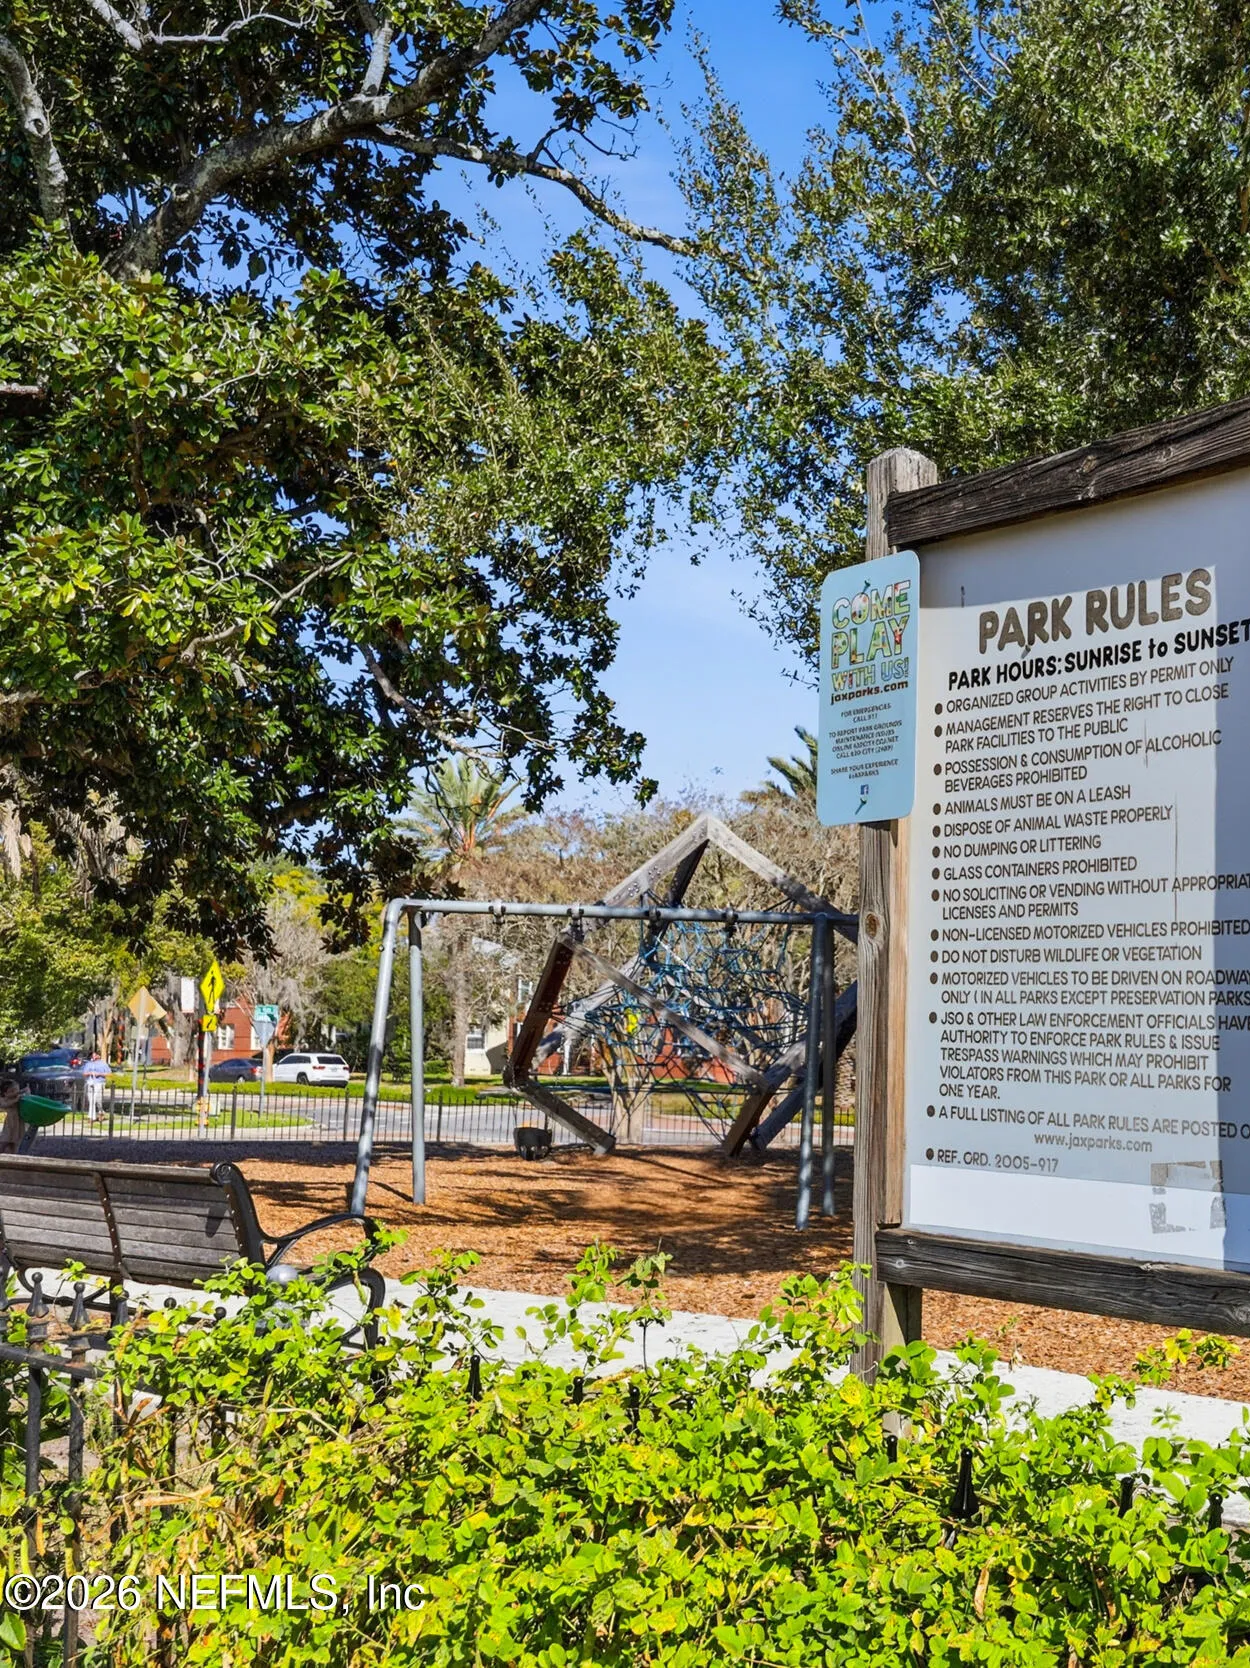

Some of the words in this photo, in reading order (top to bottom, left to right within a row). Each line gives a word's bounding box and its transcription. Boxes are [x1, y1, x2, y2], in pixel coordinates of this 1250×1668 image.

[832, 580, 911, 629] COME
[979, 596, 1072, 654] PARK
[1086, 569, 1211, 635] RULES
[831, 615, 910, 669] PLAY
[832, 664, 875, 692] WITH
[881, 657, 909, 681] US!
[949, 666, 991, 691] PARK
[1148, 638, 1168, 659] to
[831, 680, 908, 705] jaxparks.com
[946, 691, 1014, 713] ORGANIZED
[1016, 685, 1057, 704] GROUP
[1060, 674, 1127, 697] ACTIVITIES
[1129, 670, 1147, 687] BY
[1150, 662, 1197, 684] PERMIT
[1199, 657, 1234, 676] ONLY
[946, 711, 1030, 736] MANAGEMENT
[1033, 703, 1093, 725] RESERVES
[1096, 699, 1121, 716] THE
[1123, 692, 1161, 712] RIGHT
[1164, 690, 1183, 706] TO
[1185, 683, 1229, 703] CLOSE
[945, 738, 974, 754] PARK
[976, 730, 1035, 750] FACILITIES
[1038, 727, 1055, 742] TO
[1057, 723, 1081, 740] THE
[1084, 718, 1128, 737] PUBLIC
[945, 755, 1017, 775] POSSESSION
[1020, 753, 1028, 768] &
[1031, 742, 1122, 766] CONSUMPTION
[1125, 739, 1143, 755] OF
[1145, 730, 1222, 754] ALCOHOLIC
[945, 773, 1013, 793] BEVERAGES
[1016, 766, 1087, 786] PROHIBITED
[944, 797, 998, 815] ANIMALS
[1000, 794, 1034, 810] MUST
[1036, 792, 1052, 807] BE
[1054, 790, 1073, 806] ON
[1076, 789, 1087, 804] A
[1089, 784, 1131, 803] LEASH
[944, 820, 992, 837] DISPOSE
[995, 819, 1011, 833] OF
[1013, 816, 1061, 832] ANIMAL
[1064, 810, 1108, 828] WASTE
[1110, 805, 1173, 824] PROPERLY
[944, 844, 962, 858] NO
[964, 840, 1017, 858] DUMPING
[1020, 839, 1037, 854] OR
[1040, 835, 1101, 853] LITTERING
[944, 865, 982, 881] GLASS
[985, 861, 1059, 879] CONTAINERS
[1062, 856, 1137, 875] PROHIBITED
[943, 888, 961, 902] NO
[963, 885, 1027, 902] SOLICITING
[1029, 884, 1047, 899] OR
[1049, 881, 1105, 898] VENDING
[1107, 878, 1168, 895] WITHOUT
[943, 905, 996, 920] LICENSES
[998, 904, 1025, 918] AND
[1028, 901, 1078, 917] PERMITS
[942, 926, 1031, 942] NON-LICENSED
[1033, 924, 1105, 940] MOTORIZED
[1107, 922, 1167, 938] VEHICLES
[942, 950, 960, 964] DO
[962, 949, 988, 963] NOT
[990, 948, 1041, 963] DISTURB
[1043, 947, 1099, 963] WILDLIFE
[1101, 947, 1119, 962] OR
[1122, 945, 1202, 962] VEGETATION
[941, 971, 1009, 986] MOTORIZED
[1011, 971, 1068, 986] VEHICLES
[1071, 971, 1089, 985] TO
[1091, 970, 1108, 985] BE
[1111, 970, 1158, 986] DRIVEN
[1161, 970, 1182, 985] ON
[941, 990, 971, 1004] ONLY
[995, 990, 1017, 1004] ALL
[1020, 990, 1058, 1005] PARKS
[1061, 990, 1108, 1005] EXCEPT
[1110, 990, 1205, 1006] PRESERVATION
[941, 1011, 964, 1025] JSO
[967, 1012, 974, 1026] &
[977, 1012, 1017, 1026] OTHER
[1019, 1012, 1047, 1027] LAW
[1050, 1013, 1144, 1029] ENFORCEMENT
[1146, 1014, 1215, 1030] OFFICIALS
[940, 1030, 1008, 1044] AUTHORITY
[1010, 1031, 1027, 1045] TO
[1030, 1031, 1087, 1047] ENFORCE
[1090, 1032, 1122, 1048] PARK
[1125, 1033, 1166, 1049] RULES
[1169, 1034, 1178, 1050] &
[1181, 1034, 1220, 1051] ISSUE
[940, 1047, 999, 1063] TRESPASS
[1001, 1049, 1067, 1066] WARNINGS
[1070, 1051, 1112, 1067] WHICH
[1115, 1053, 1143, 1068] MAY
[1146, 1053, 1209, 1070] PROHIBIT
[939, 1083, 964, 1098] ONE
[966, 1085, 1000, 1099] YEAR.
[940, 1065, 1004, 1082] VIOLATORS
[1007, 1068, 1041, 1083] FROM
[1044, 1069, 1072, 1085] THIS
[1074, 1070, 1107, 1086] PARK
[1109, 1072, 1128, 1087] OR
[1130, 1073, 1155, 1089] ALL
[1158, 1074, 1201, 1091] PARKS
[1204, 1076, 1231, 1092] FOR
[939, 1105, 948, 1119] A
[950, 1106, 978, 1121] FULL
[981, 1108, 1025, 1124] LISTING
[1027, 1111, 1045, 1125] OF
[1046, 1112, 1070, 1127] ALL
[1073, 1113, 1106, 1130] PARK
[1108, 1115, 1149, 1132] RULES
[1151, 1118, 1178, 1135] ARE
[1182, 1120, 1238, 1138] POSTED
[1034, 1134, 1152, 1152] www.jaxparks.com
[937, 1149, 961, 1164] REF.
[963, 1151, 991, 1166] ORD.
[994, 1154, 1059, 1172] 2005-917
